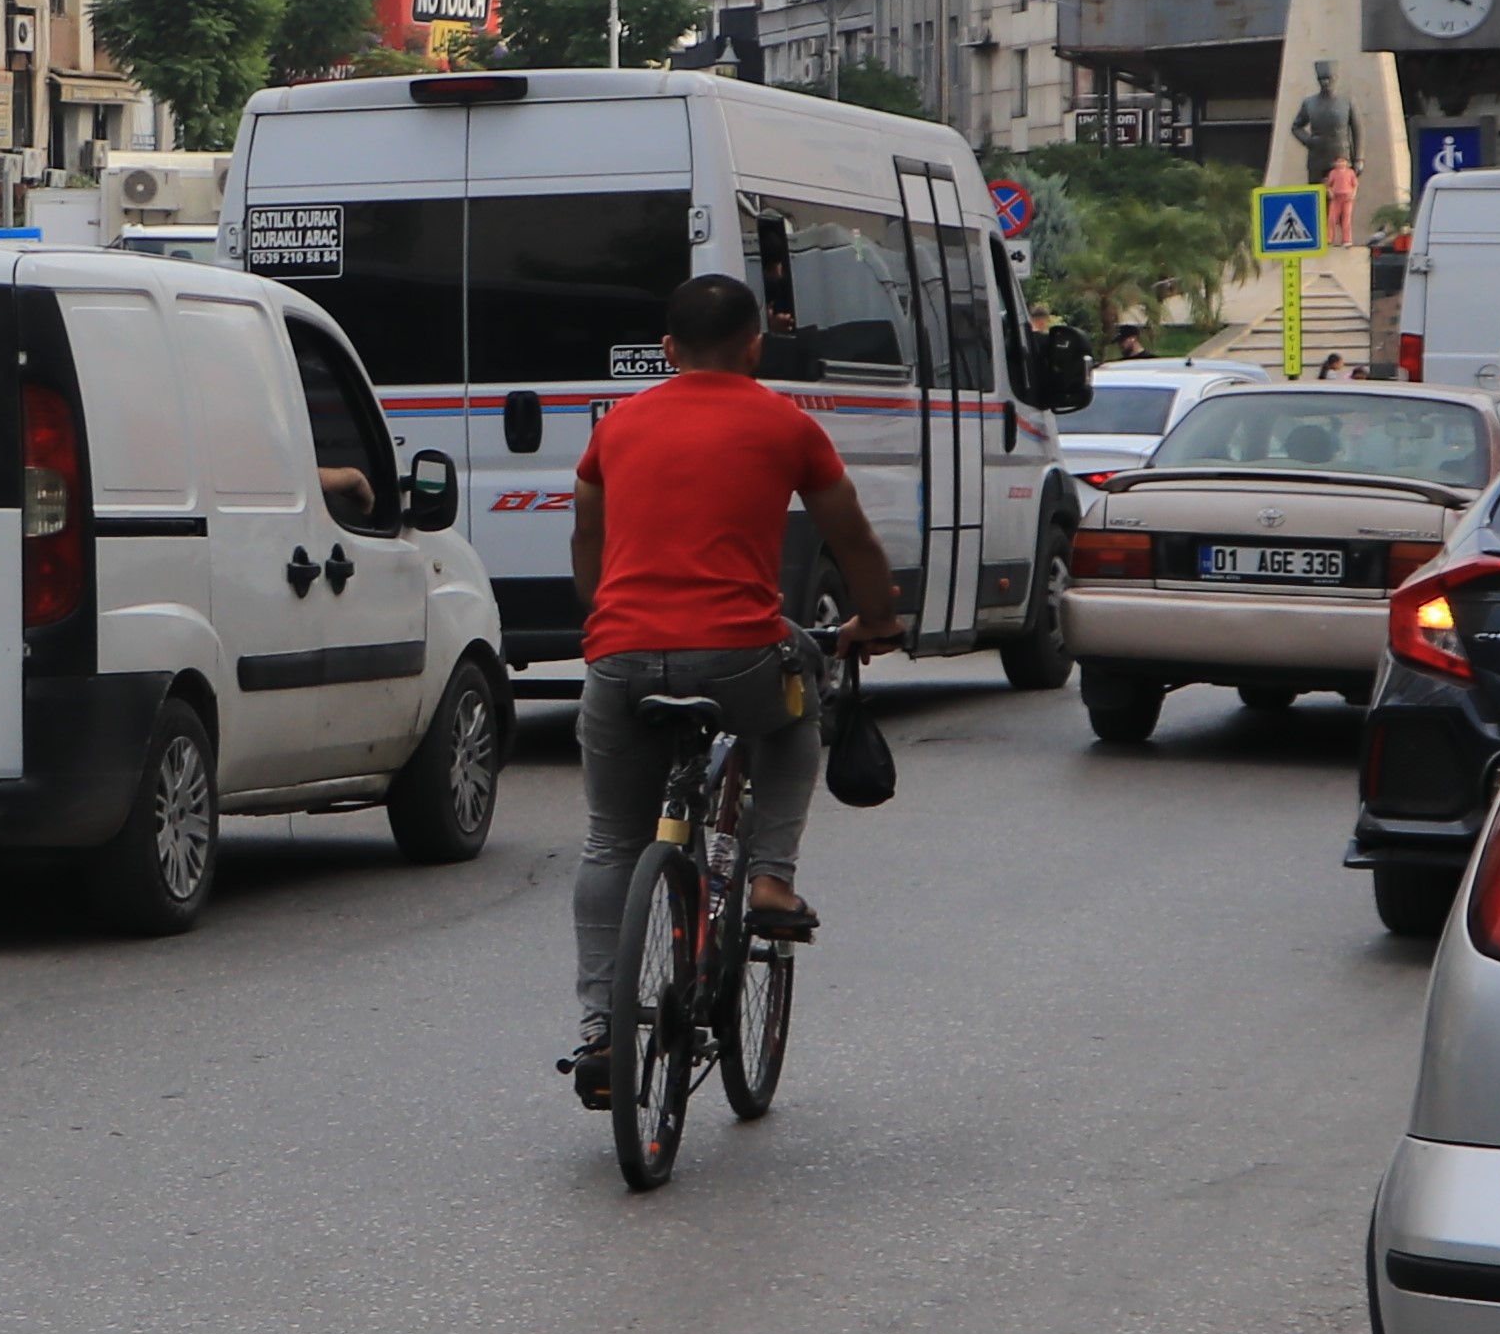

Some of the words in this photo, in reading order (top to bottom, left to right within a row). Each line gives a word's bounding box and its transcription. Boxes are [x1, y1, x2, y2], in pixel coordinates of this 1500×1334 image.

[252, 210, 294, 229] SATILIK
[297, 209, 338, 228] DURAK
[252, 230, 302, 248] DURAKLI
[304, 229, 338, 249] ARAÇ
[252, 252, 280, 265] 0539
[282, 252, 304, 264] 210
[306, 251, 321, 264] 58
[323, 250, 338, 263] 84
[613, 360, 680, 373] ALO:15
[1214, 548, 1238, 572] 01
[1257, 549, 1295, 574] AGE
[1302, 552, 1340, 576] 336
